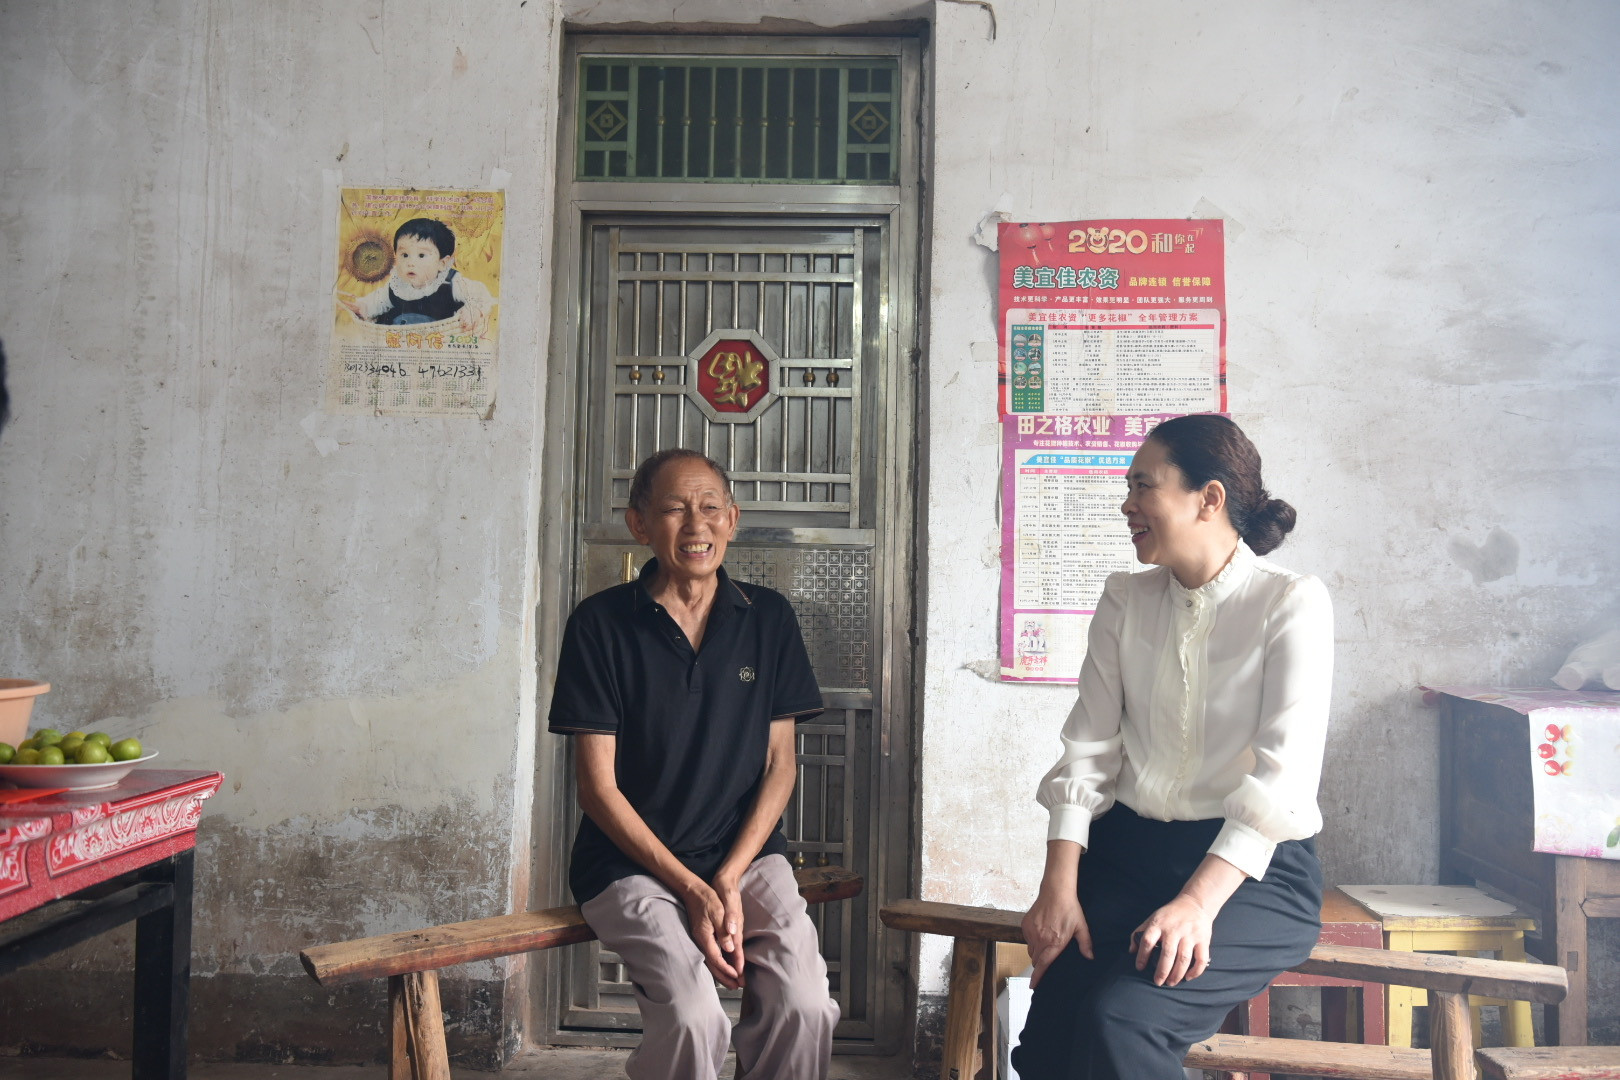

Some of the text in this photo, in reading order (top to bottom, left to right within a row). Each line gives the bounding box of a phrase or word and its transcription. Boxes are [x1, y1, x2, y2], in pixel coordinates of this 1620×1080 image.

[1068, 227, 1148, 254] 2020
[1013, 266, 1119, 289] 美宜佳农资
[1129, 276, 1212, 288] 品牌连锁 信誉保障
[1028, 312, 1077, 322] 美宜佳农资
[1138, 312, 1199, 322] 全年管理方案
[449, 335, 478, 345] 2003
[1018, 415, 1176, 437] 田之格农业 美宜
